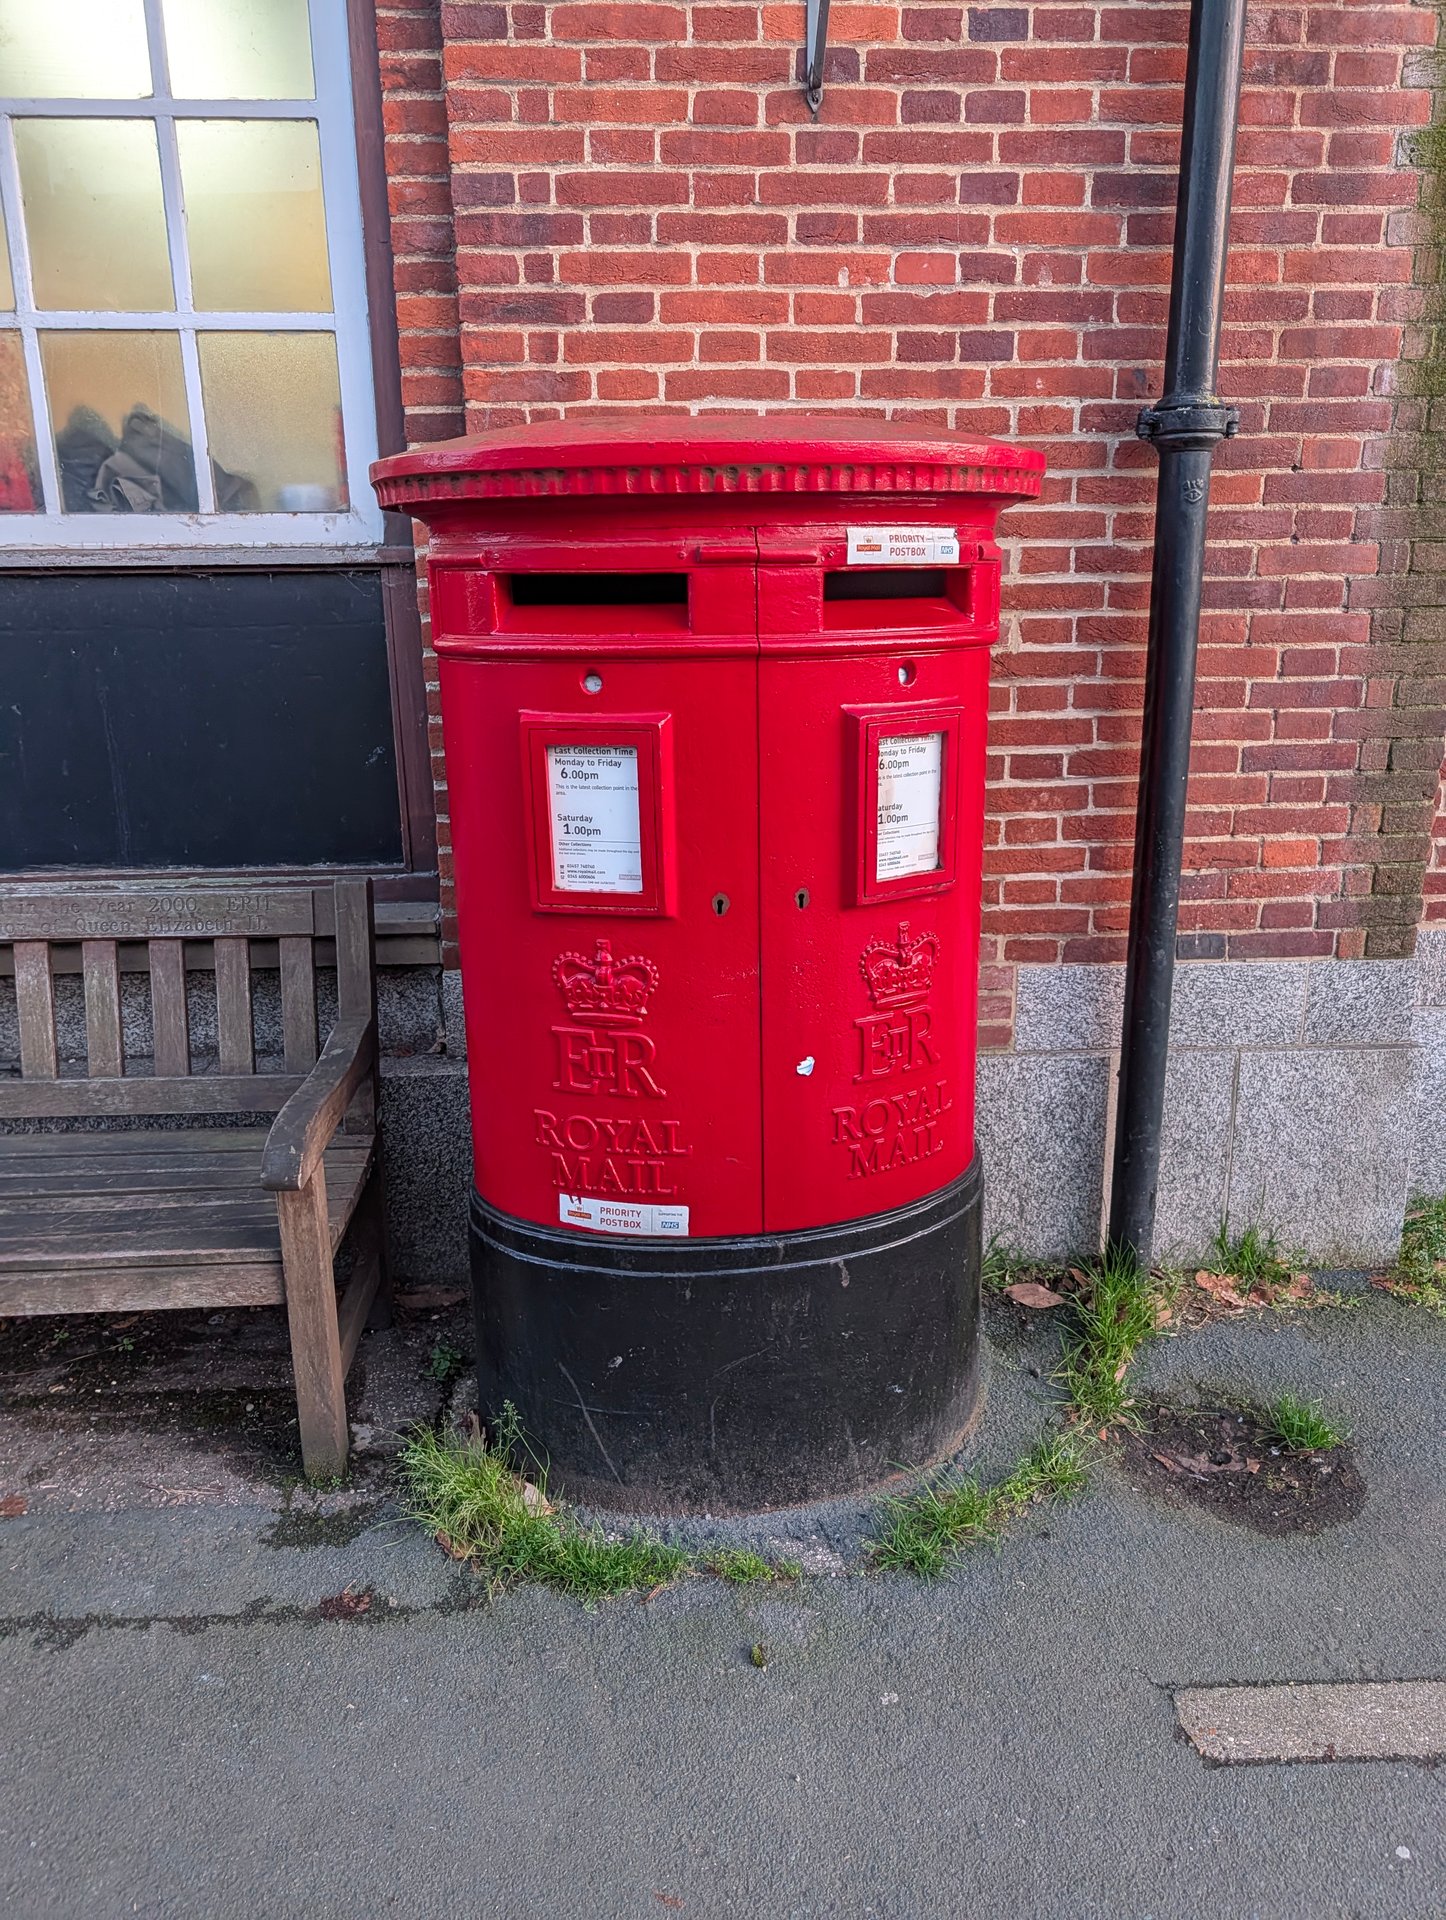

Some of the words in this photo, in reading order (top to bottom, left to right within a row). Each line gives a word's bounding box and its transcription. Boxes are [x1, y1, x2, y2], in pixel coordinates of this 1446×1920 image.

[889, 534, 925, 543] PRIORITY
[889, 547, 926, 556] POSTBOX
[941, 546, 953, 554] NHS
[554, 747, 571, 755] Last
[573, 747, 611, 755] Collection
[613, 747, 634, 755] Time
[878, 748, 899, 757] onday
[554, 758, 584, 767] Monday
[598, 759, 622, 768] Friday
[879, 758, 909, 770] 6.00pm
[560, 767, 599, 781] 6.00pm
[878, 803, 903, 811] aturday
[557, 813, 593, 823] Saturday
[878, 813, 909, 824] 1.00pm
[563, 823, 601, 837] 1.00pm
[226, 895, 273, 913] ERII
[75, 917, 131, 933] Queen
[146, 914, 233, 932] Elizabeth
[831, 1080, 953, 1144] ROYAL
[534, 1108, 693, 1155] ROYAL
[848, 1120, 944, 1180] MAIL
[551, 1152, 678, 1195] MAIL
[600, 1206, 641, 1218] PRIORITY
[600, 1217, 641, 1229] POSTBOX
[661, 1221, 679, 1229] NHS
